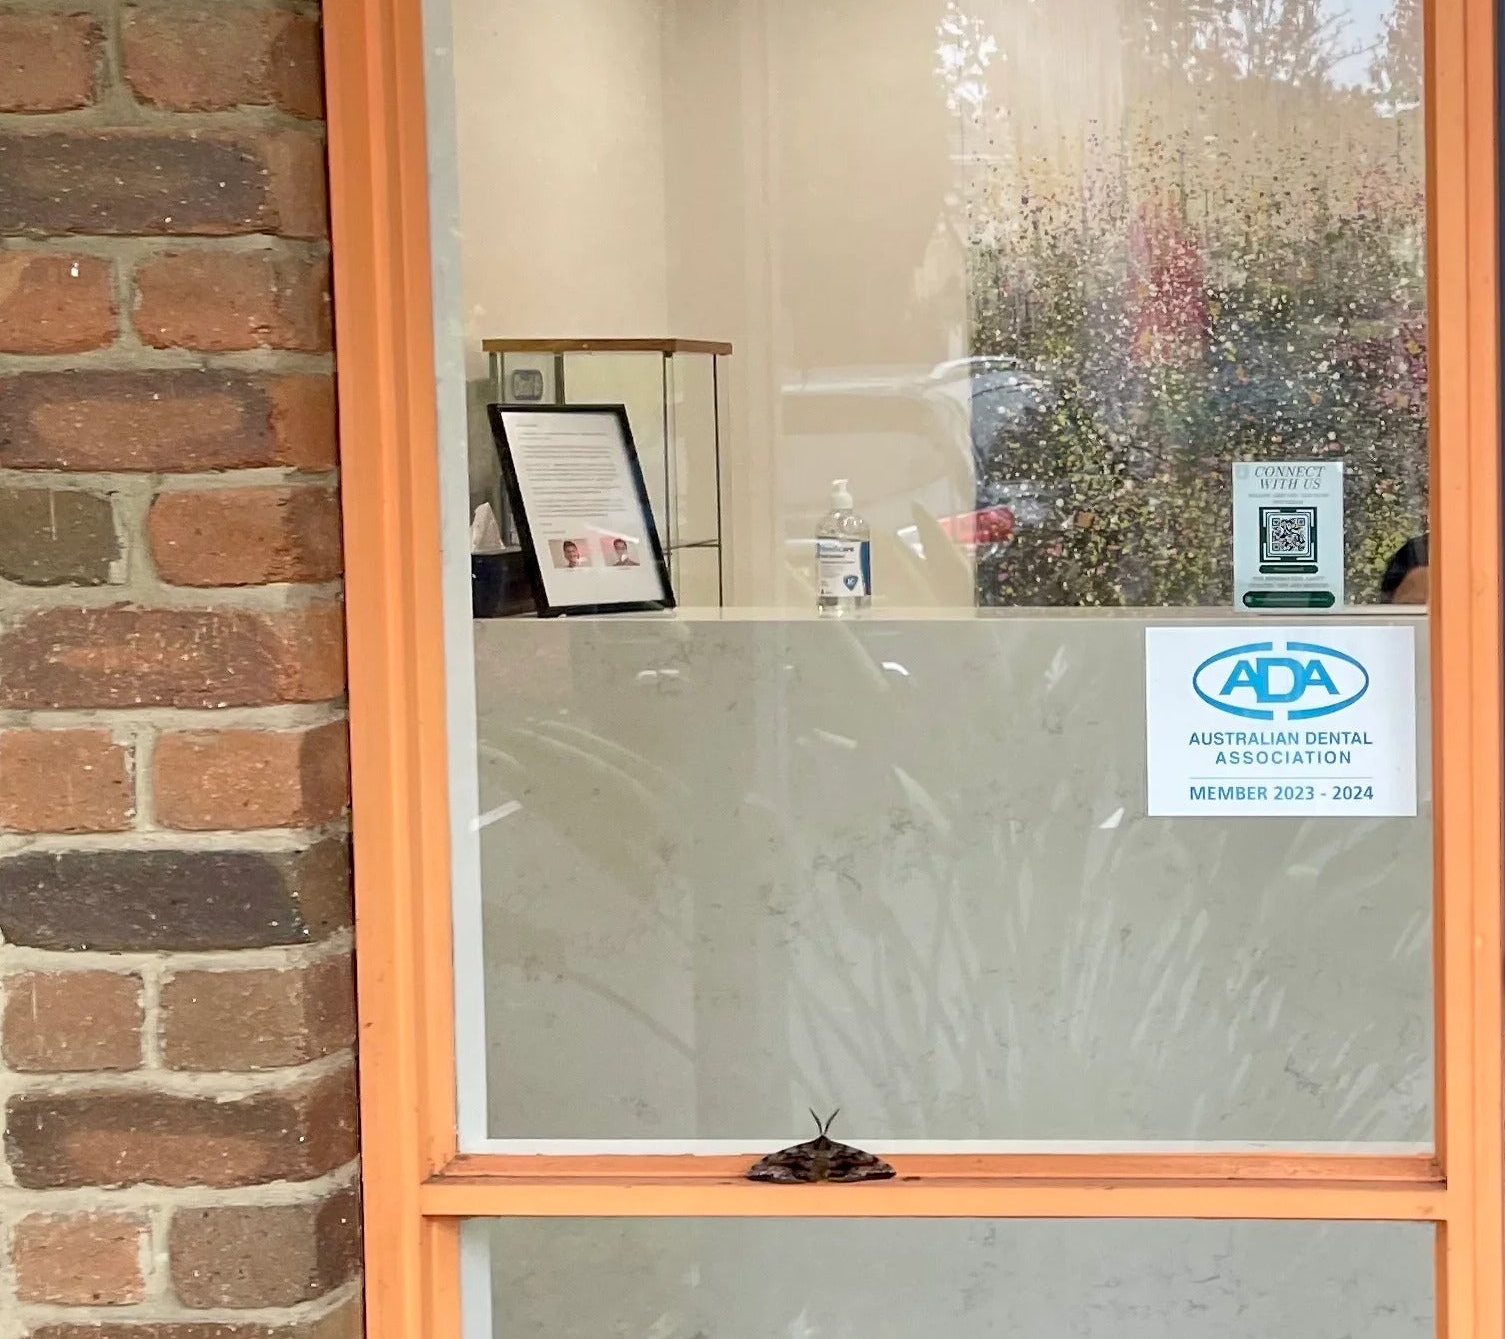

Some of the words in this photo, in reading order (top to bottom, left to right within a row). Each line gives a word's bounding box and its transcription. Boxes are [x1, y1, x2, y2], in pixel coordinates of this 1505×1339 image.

[1254, 466, 1326, 478] CONNECT
[1260, 478, 1297, 490] WITH
[1303, 478, 1321, 490] US
[1219, 657, 1341, 703] ADA
[1189, 732, 1299, 746] AUSTRALIAN
[1305, 731, 1373, 745] DENTAL
[1215, 751, 1352, 765] ASSOCIATION
[1190, 787, 1268, 801] MEMBER
[1274, 786, 1315, 800] 2023
[1332, 786, 1374, 800] 2024
